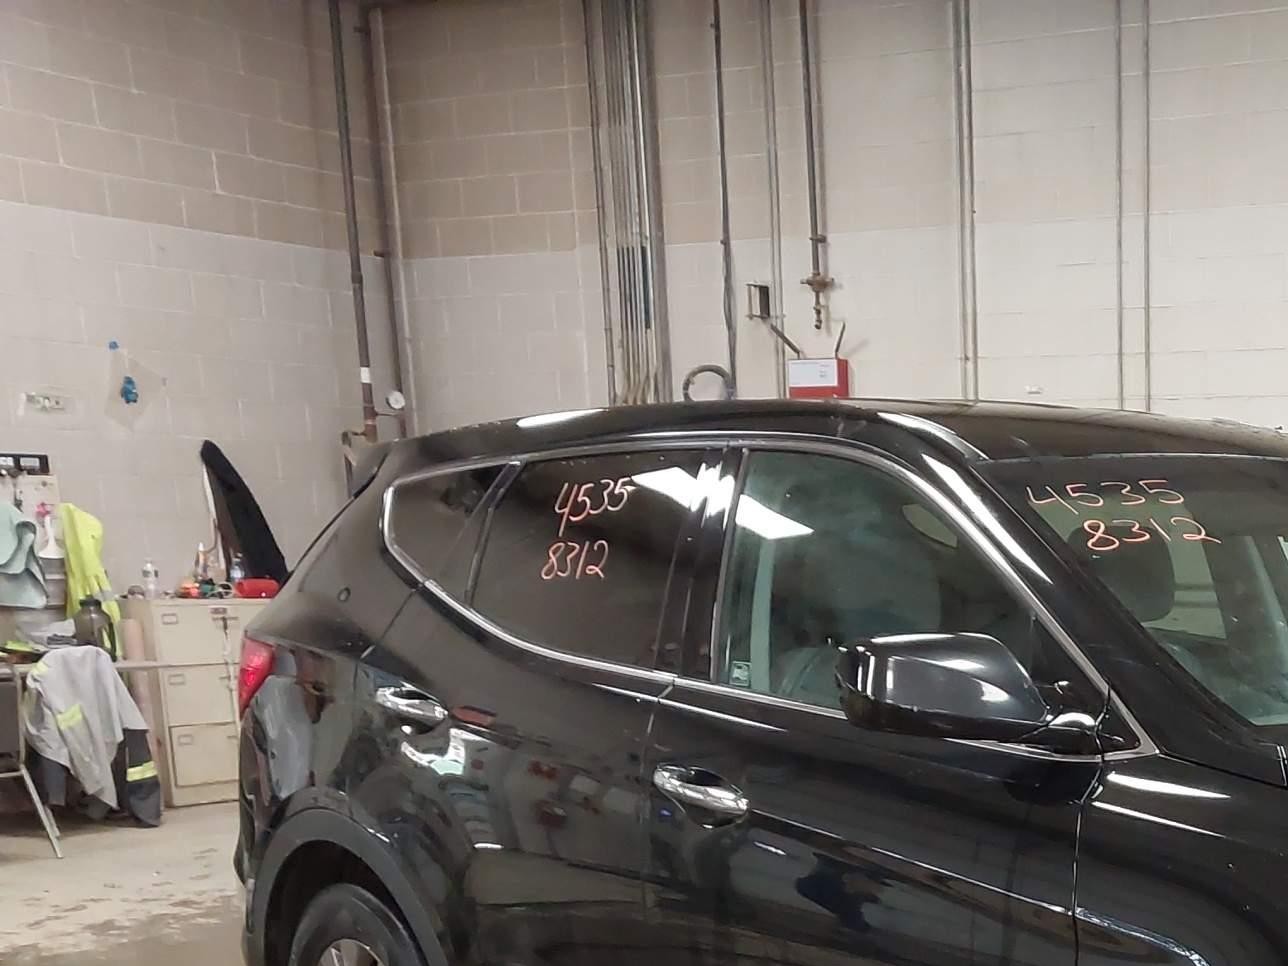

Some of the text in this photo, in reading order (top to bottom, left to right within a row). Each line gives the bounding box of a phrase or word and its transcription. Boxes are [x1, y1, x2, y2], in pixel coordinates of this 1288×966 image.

[554, 476, 632, 537] 4535
[1025, 479, 1185, 516] 4535
[1082, 516, 1222, 551] 8312
[541, 540, 609, 579] 8312
